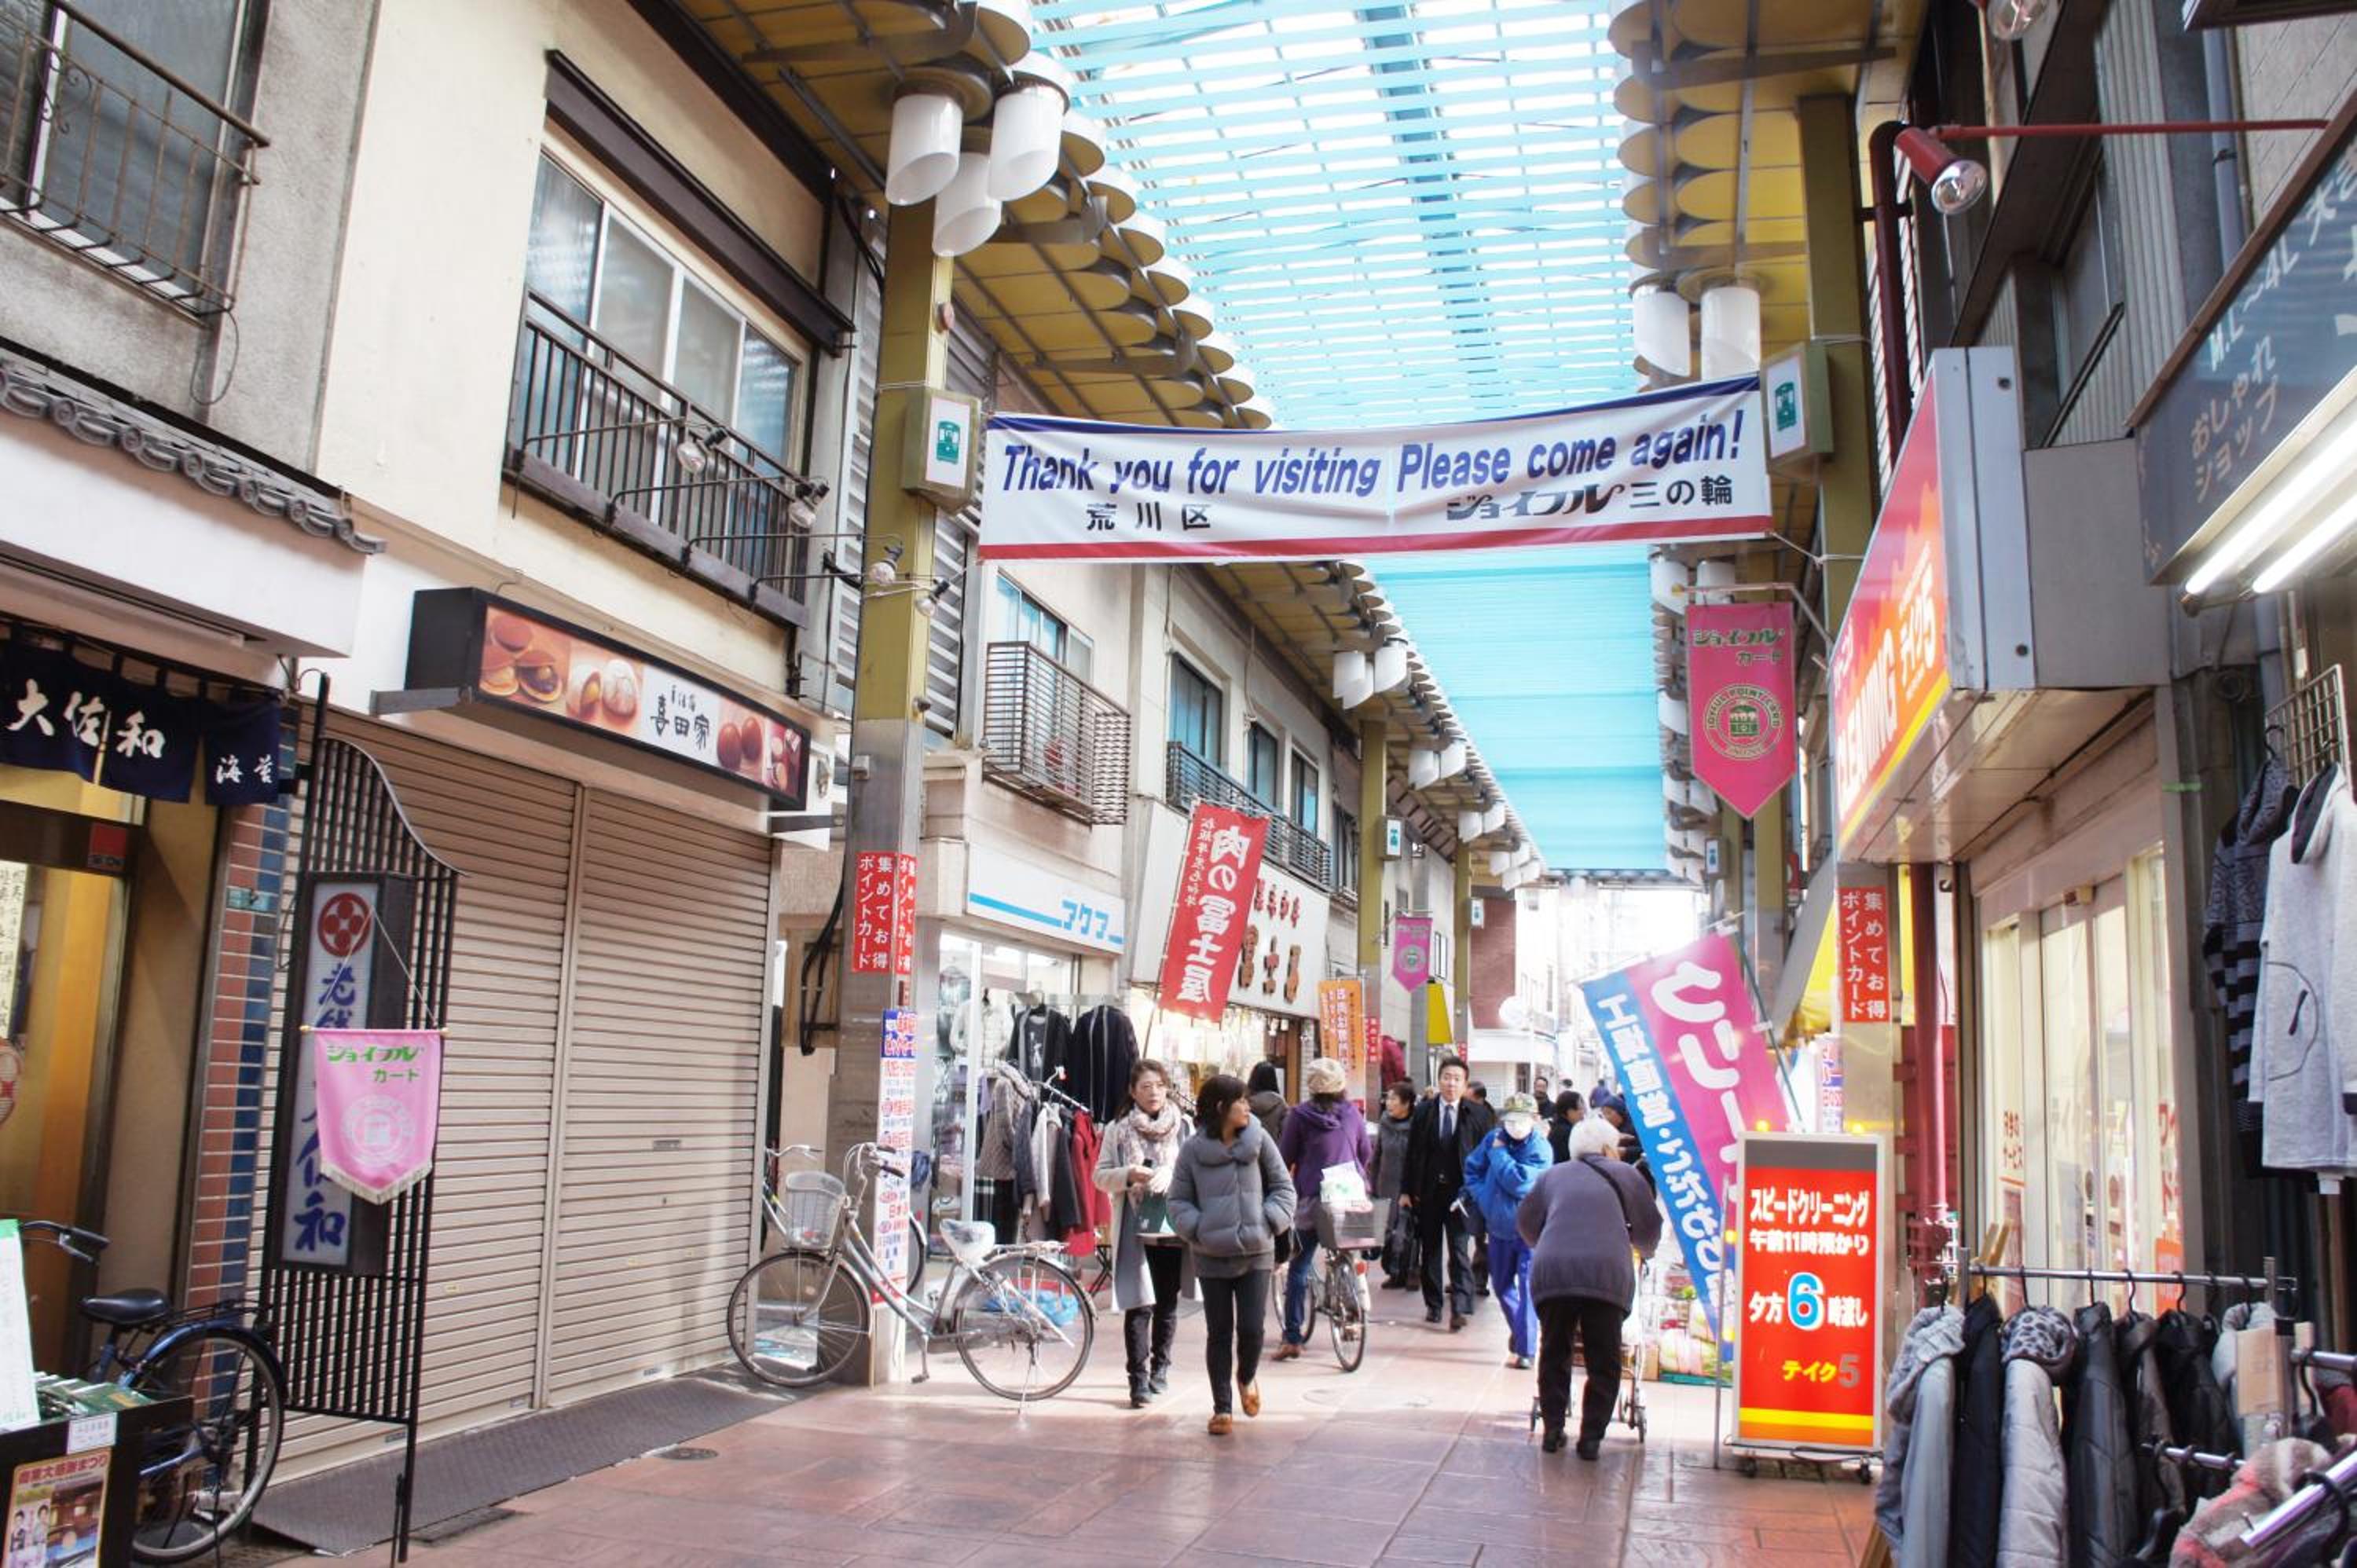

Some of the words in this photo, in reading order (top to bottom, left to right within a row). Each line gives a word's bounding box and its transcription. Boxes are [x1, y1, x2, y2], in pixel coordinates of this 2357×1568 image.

[2190, 335, 2276, 459] おしゃれ
[2194, 374, 2278, 503] ショップ
[1003, 445, 1098, 491] Thank
[1109, 459, 1172, 495] you
[1186, 447, 1240, 495] for
[1254, 446, 1381, 497] visiting
[1396, 442, 1511, 493] Please
[1527, 435, 1616, 478] come
[1630, 408, 1745, 469] again!
[1085, 501, 1211, 531] 荒川区
[3, 678, 166, 760] 大佐和
[650, 693, 709, 750] 喜田家
[857, 855, 875, 969] ポイントカード
[872, 856, 893, 969] 集めてお得
[1842, 892, 1863, 1020] ポイントカード
[1864, 892, 1886, 1019] 集めてお得
[1748, 1229, 1870, 1257] 午前11時預かり
[1749, 1185, 1870, 1228] スピードクリーニング
[1748, 1271, 1869, 1332] 夕方6時渡し
[1781, 1353, 1861, 1389] テイク5
